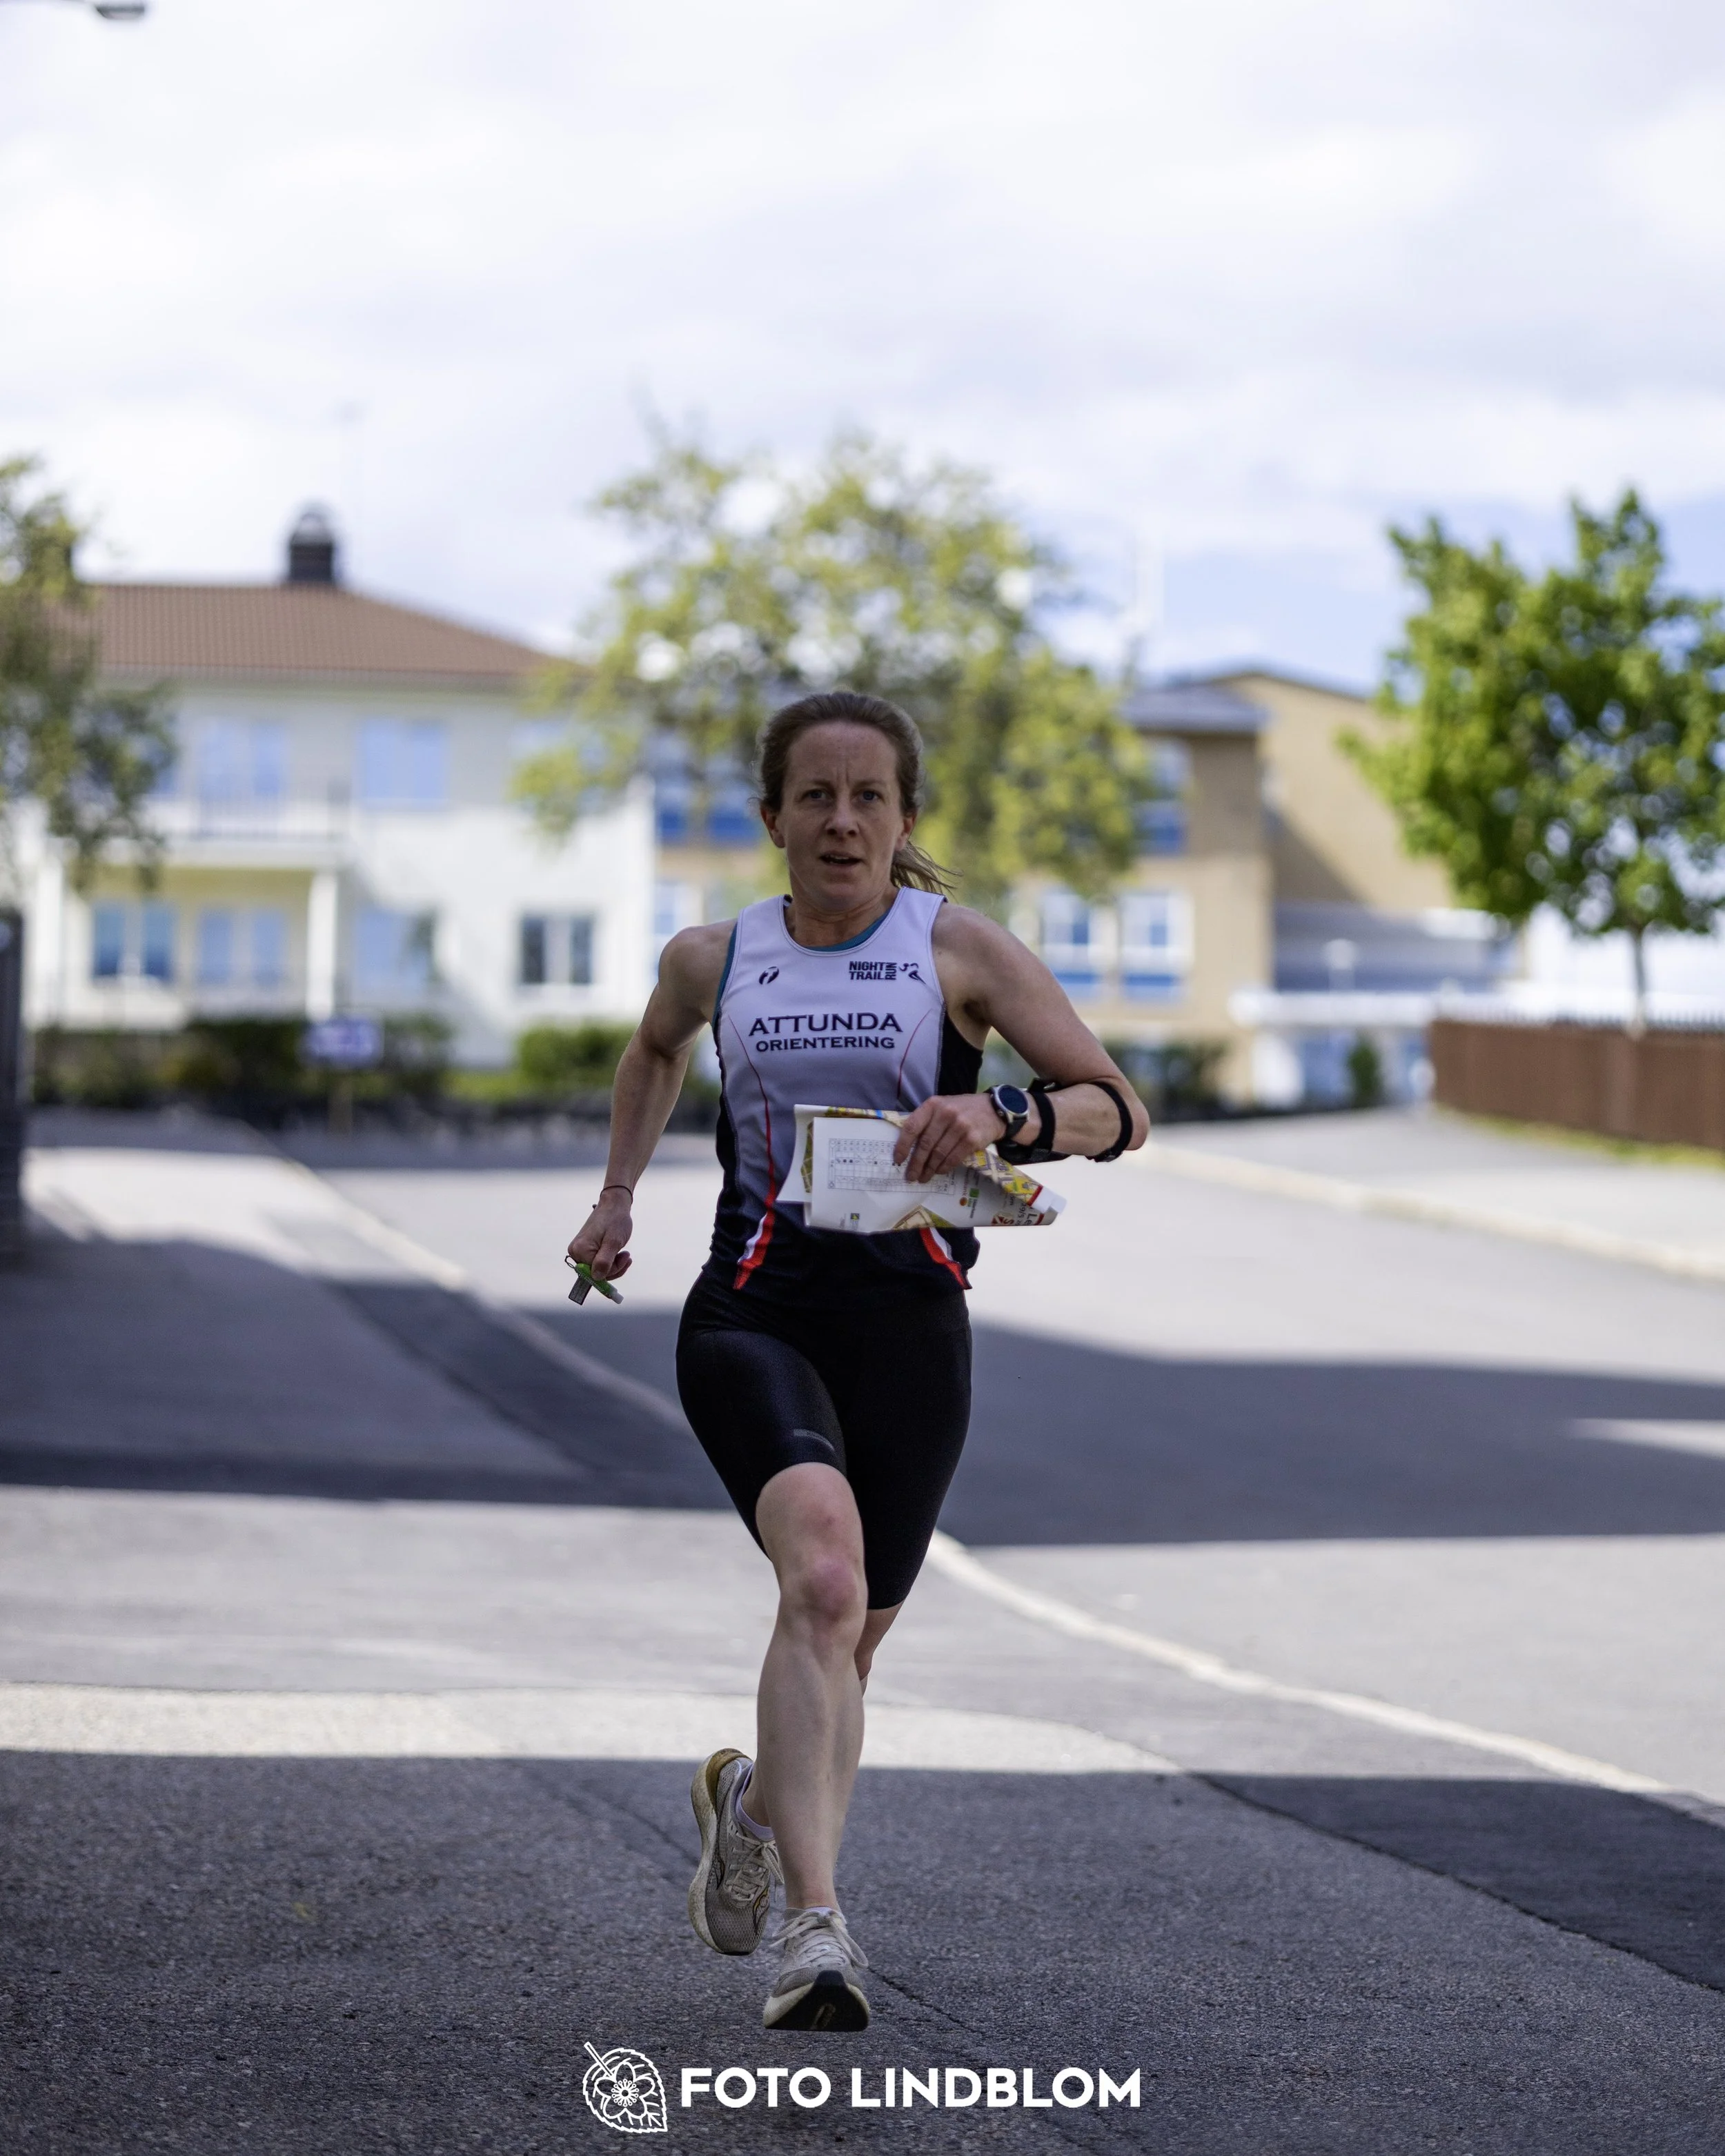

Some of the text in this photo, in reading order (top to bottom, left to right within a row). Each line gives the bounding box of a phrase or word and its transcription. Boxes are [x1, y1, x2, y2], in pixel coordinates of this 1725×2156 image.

[849, 961, 884, 971] NIGHT
[885, 962, 897, 980] RUN
[849, 971, 885, 980] TRAIL
[749, 1013, 903, 1036] ATTUNDA
[756, 1036, 895, 1052] ORIENTERING
